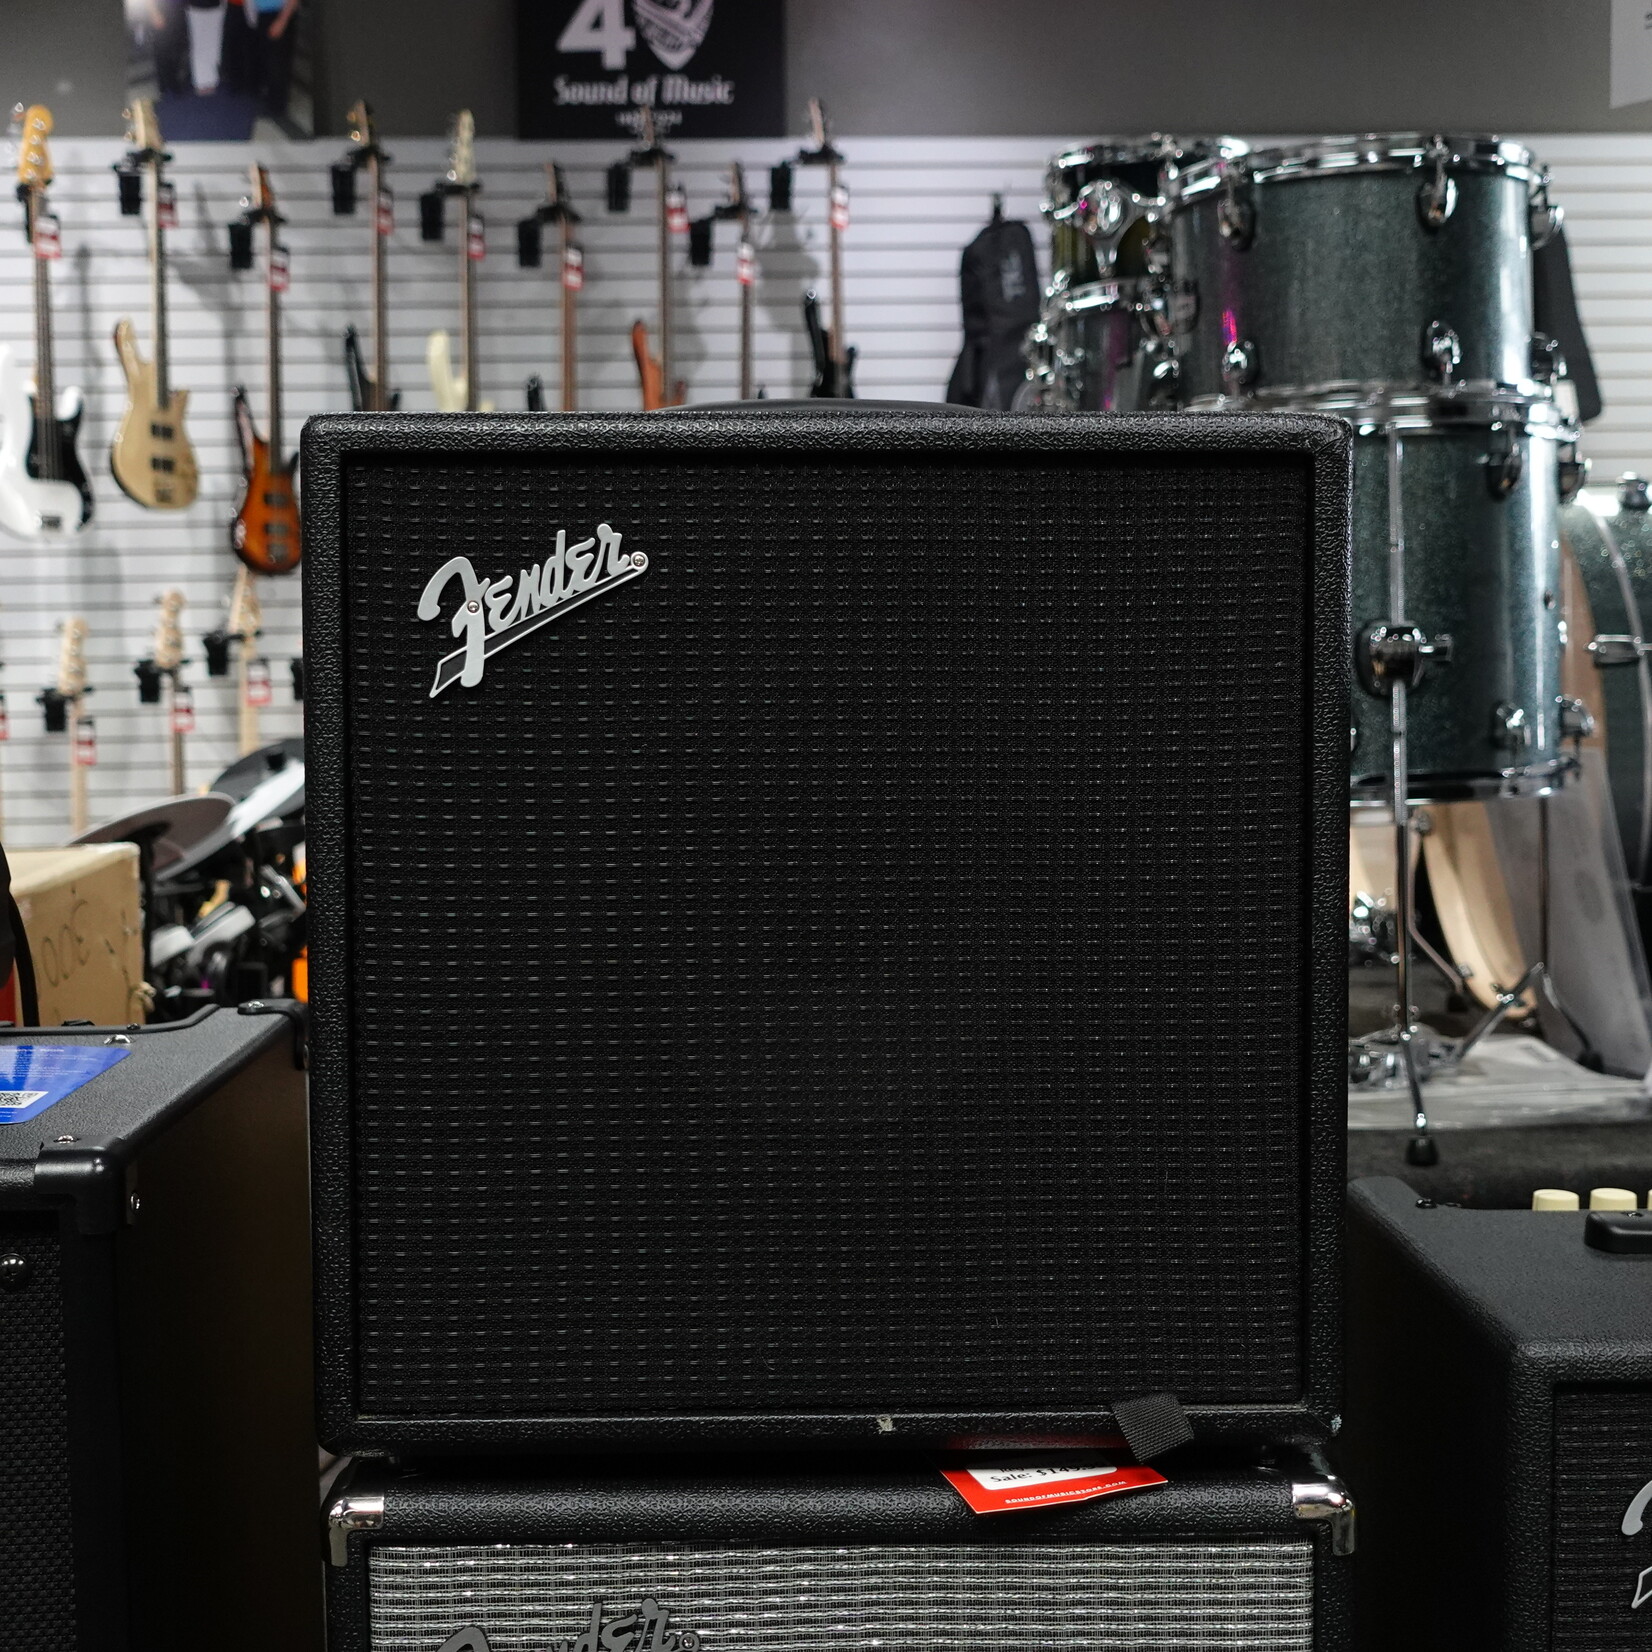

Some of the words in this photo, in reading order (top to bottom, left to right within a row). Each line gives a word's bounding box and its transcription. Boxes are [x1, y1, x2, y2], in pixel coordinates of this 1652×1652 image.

[553, 74, 628, 105] Sound
[630, 75, 659, 106] of
[661, 74, 735, 105] Music
[417, 523, 640, 688] Fender
[990, 1472, 1032, 1482] Sale:
